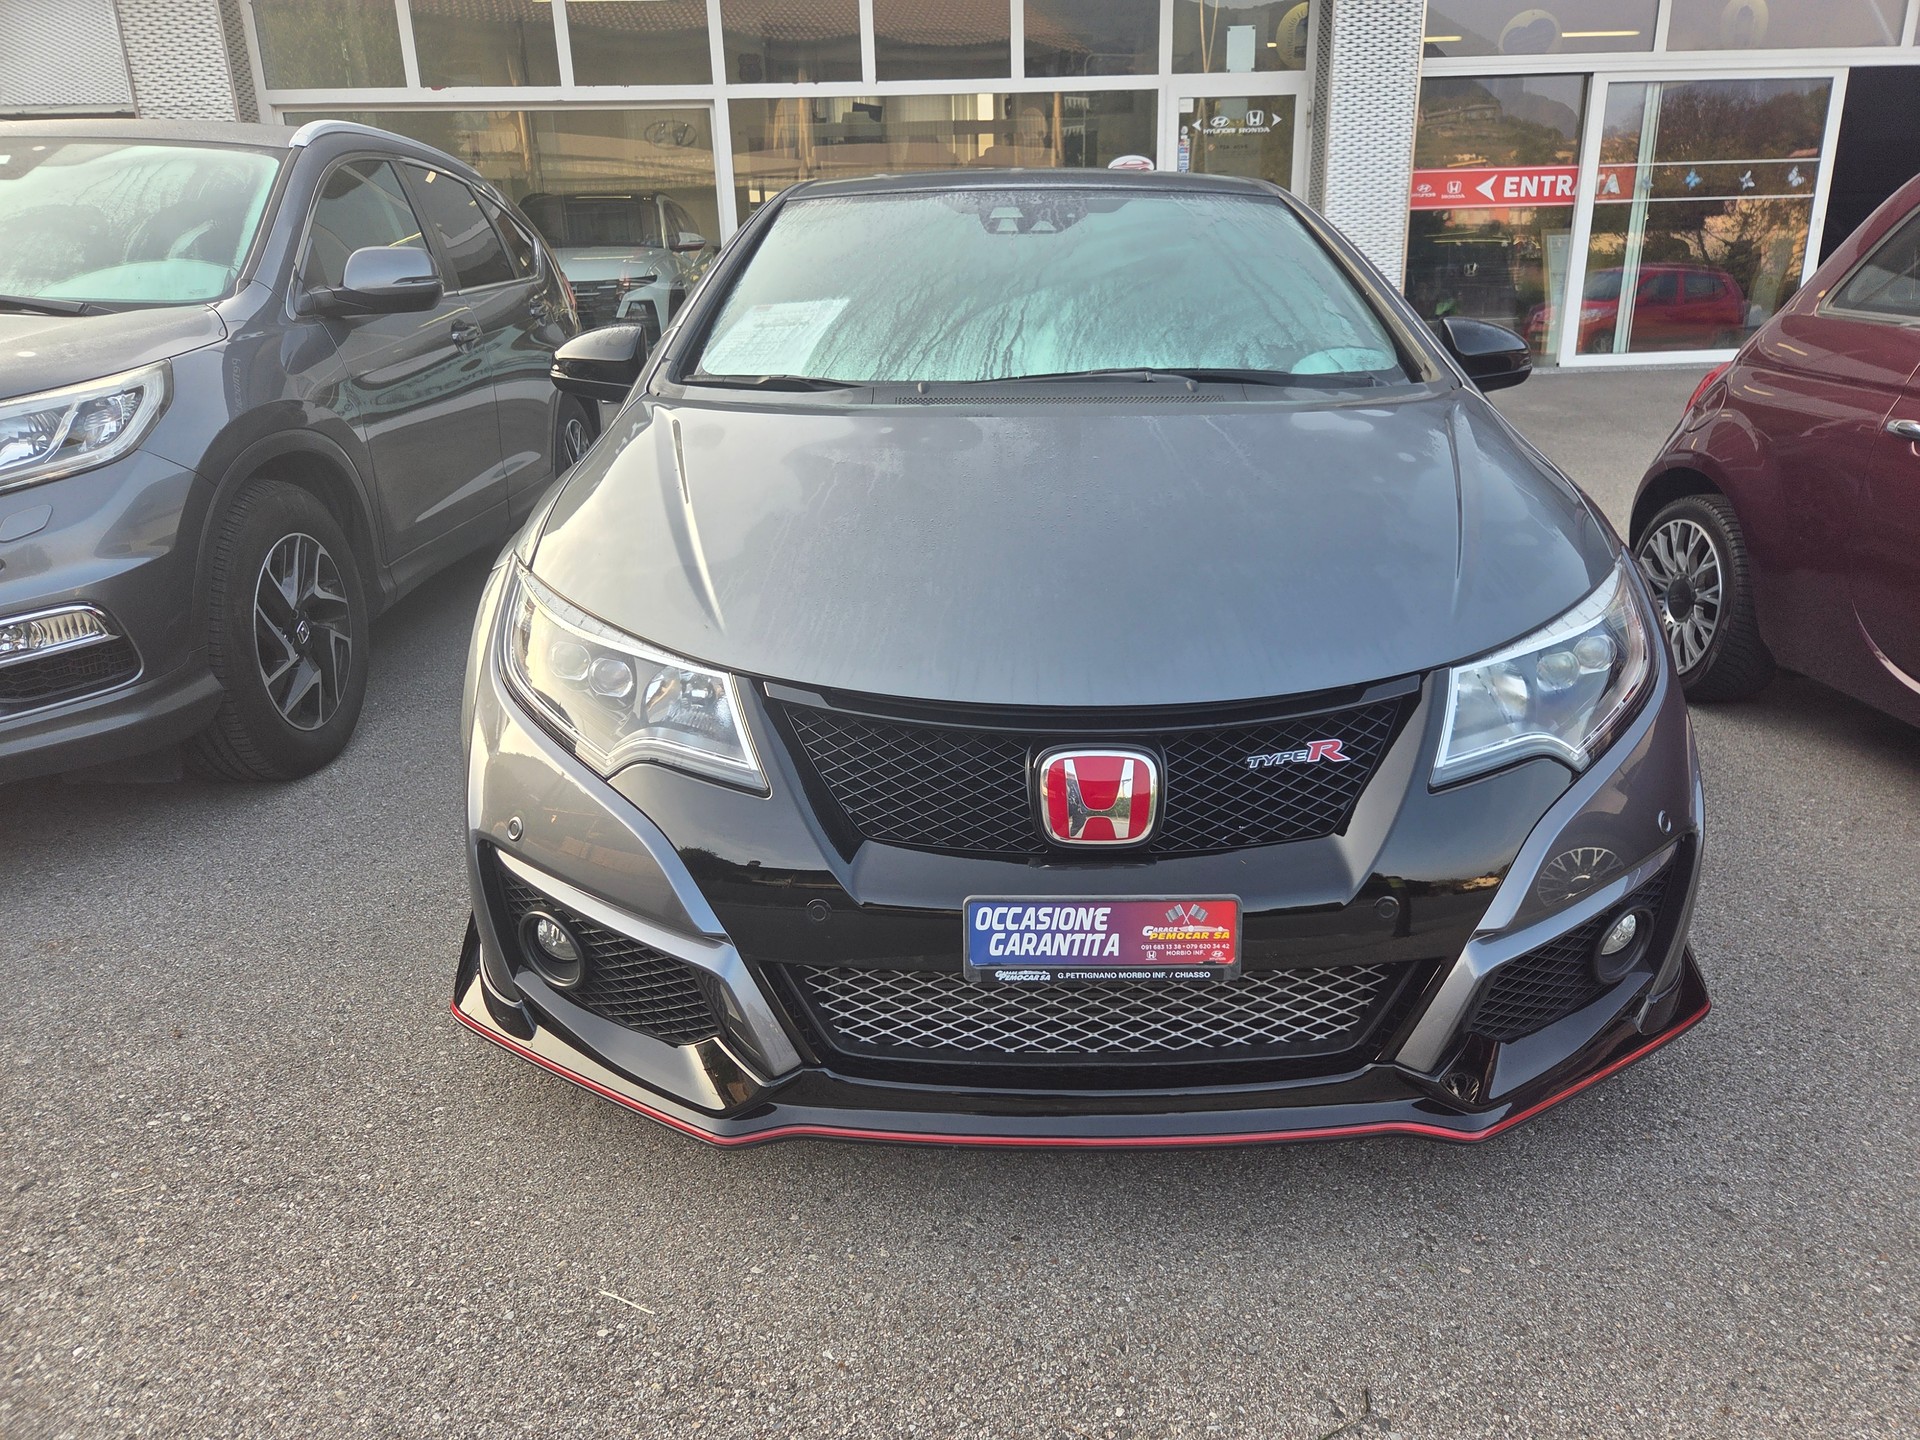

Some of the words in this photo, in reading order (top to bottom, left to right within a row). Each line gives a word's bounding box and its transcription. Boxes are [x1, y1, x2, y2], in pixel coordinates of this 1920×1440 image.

[1503, 174, 1620, 197] ENTRTA
[975, 907, 1112, 931] OCCASIONE
[1142, 925, 1180, 936] GARAGE
[1149, 931, 1210, 940] PEMOCAR
[1213, 931, 1230, 940] SA
[989, 933, 1120, 956] GARANTITA
[1152, 971, 1168, 979] INF.
